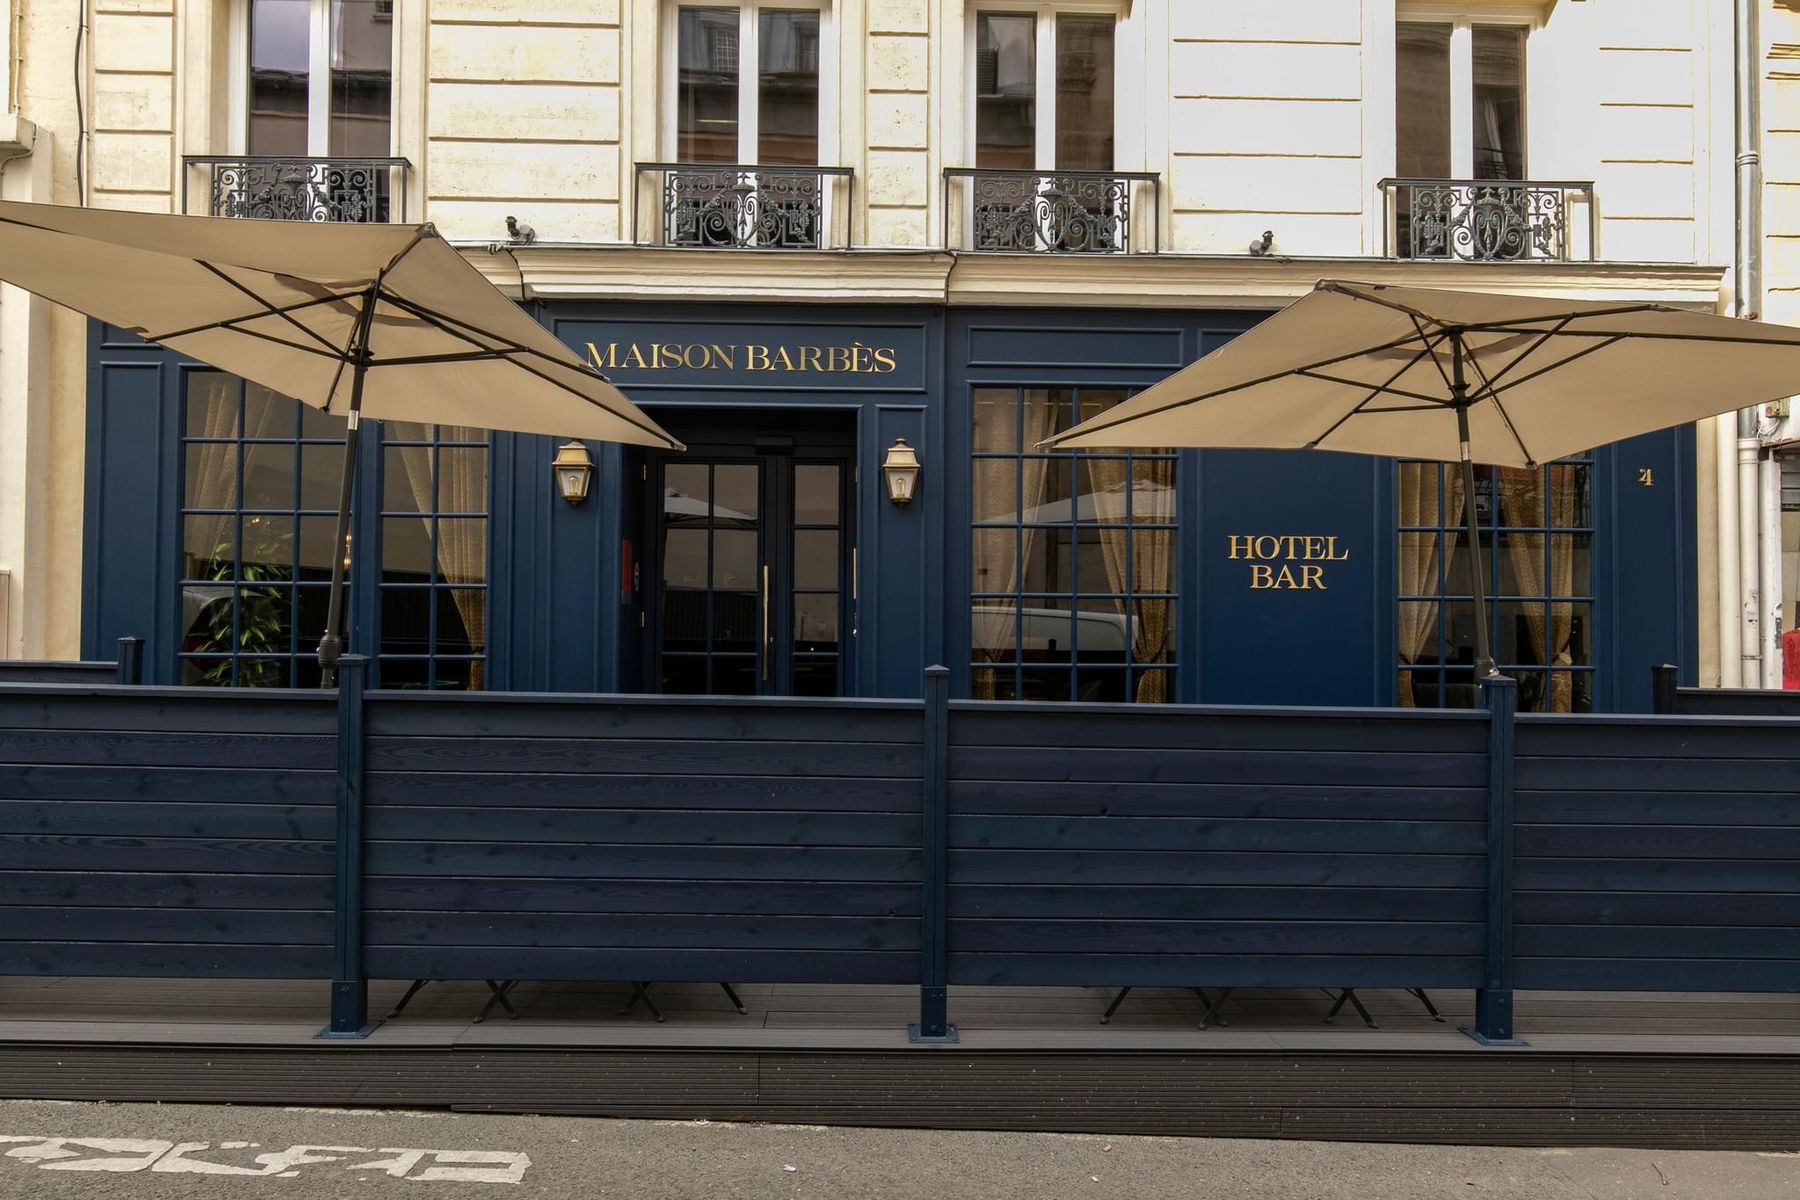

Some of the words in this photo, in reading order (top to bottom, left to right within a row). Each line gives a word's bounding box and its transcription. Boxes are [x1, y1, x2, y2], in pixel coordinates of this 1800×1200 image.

[584, 341, 740, 370] MAISON
[745, 342, 897, 373] BARBÈS
[1227, 535, 1349, 560] HOTEL
[1250, 564, 1328, 589] BAR
